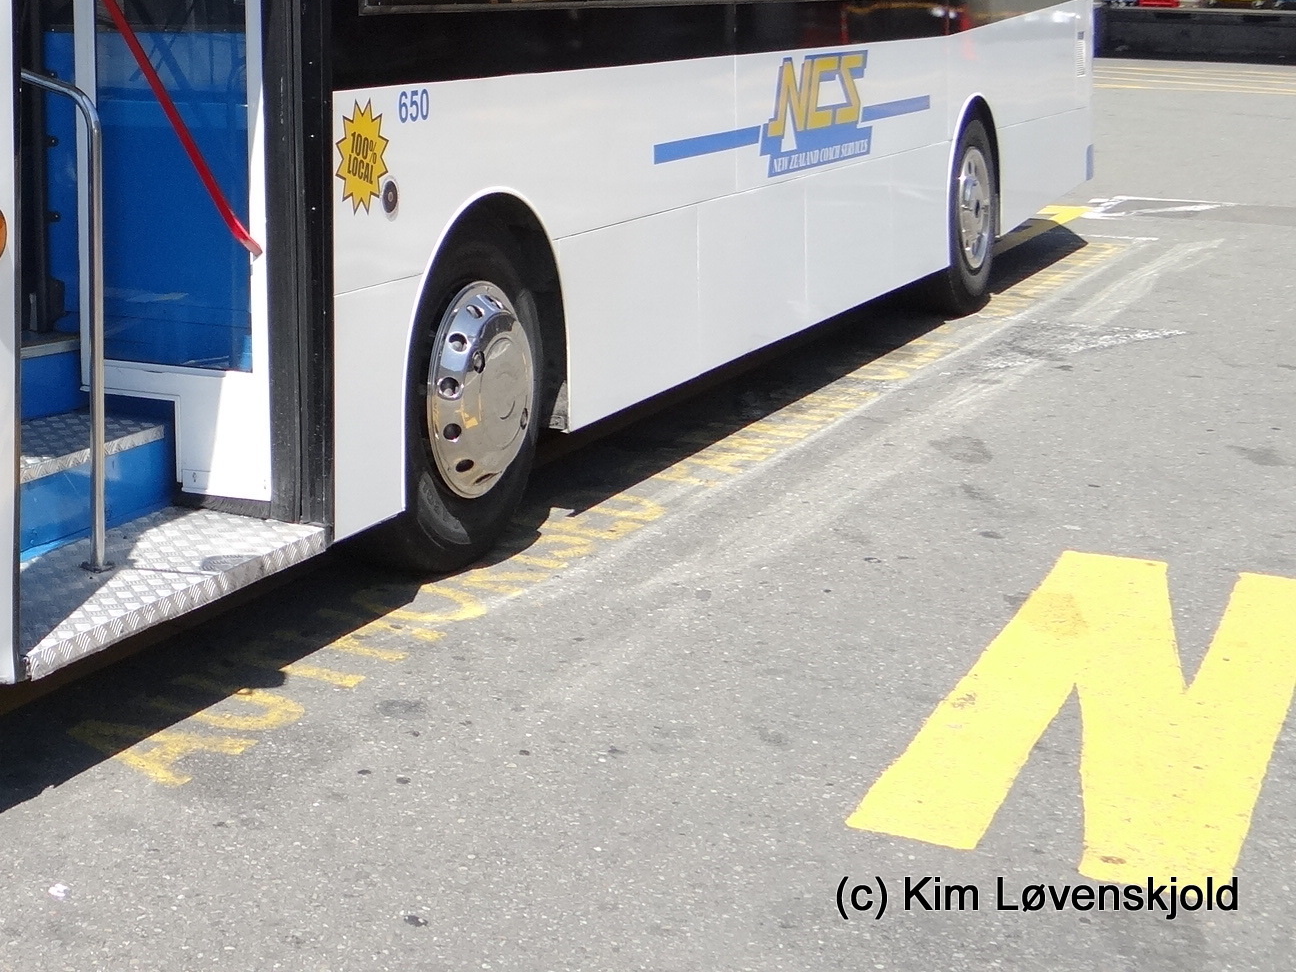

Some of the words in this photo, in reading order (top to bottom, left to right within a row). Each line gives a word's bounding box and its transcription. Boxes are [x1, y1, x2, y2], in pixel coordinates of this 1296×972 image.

[398, 88, 429, 123] 650
[765, 51, 866, 137] NCS
[350, 131, 377, 165] 100%
[772, 156, 790, 174] NEW
[789, 149, 819, 170] ZEALAND
[819, 144, 841, 164] COACH
[840, 139, 869, 158] SERVICES
[347, 154, 374, 185] LOCAL
